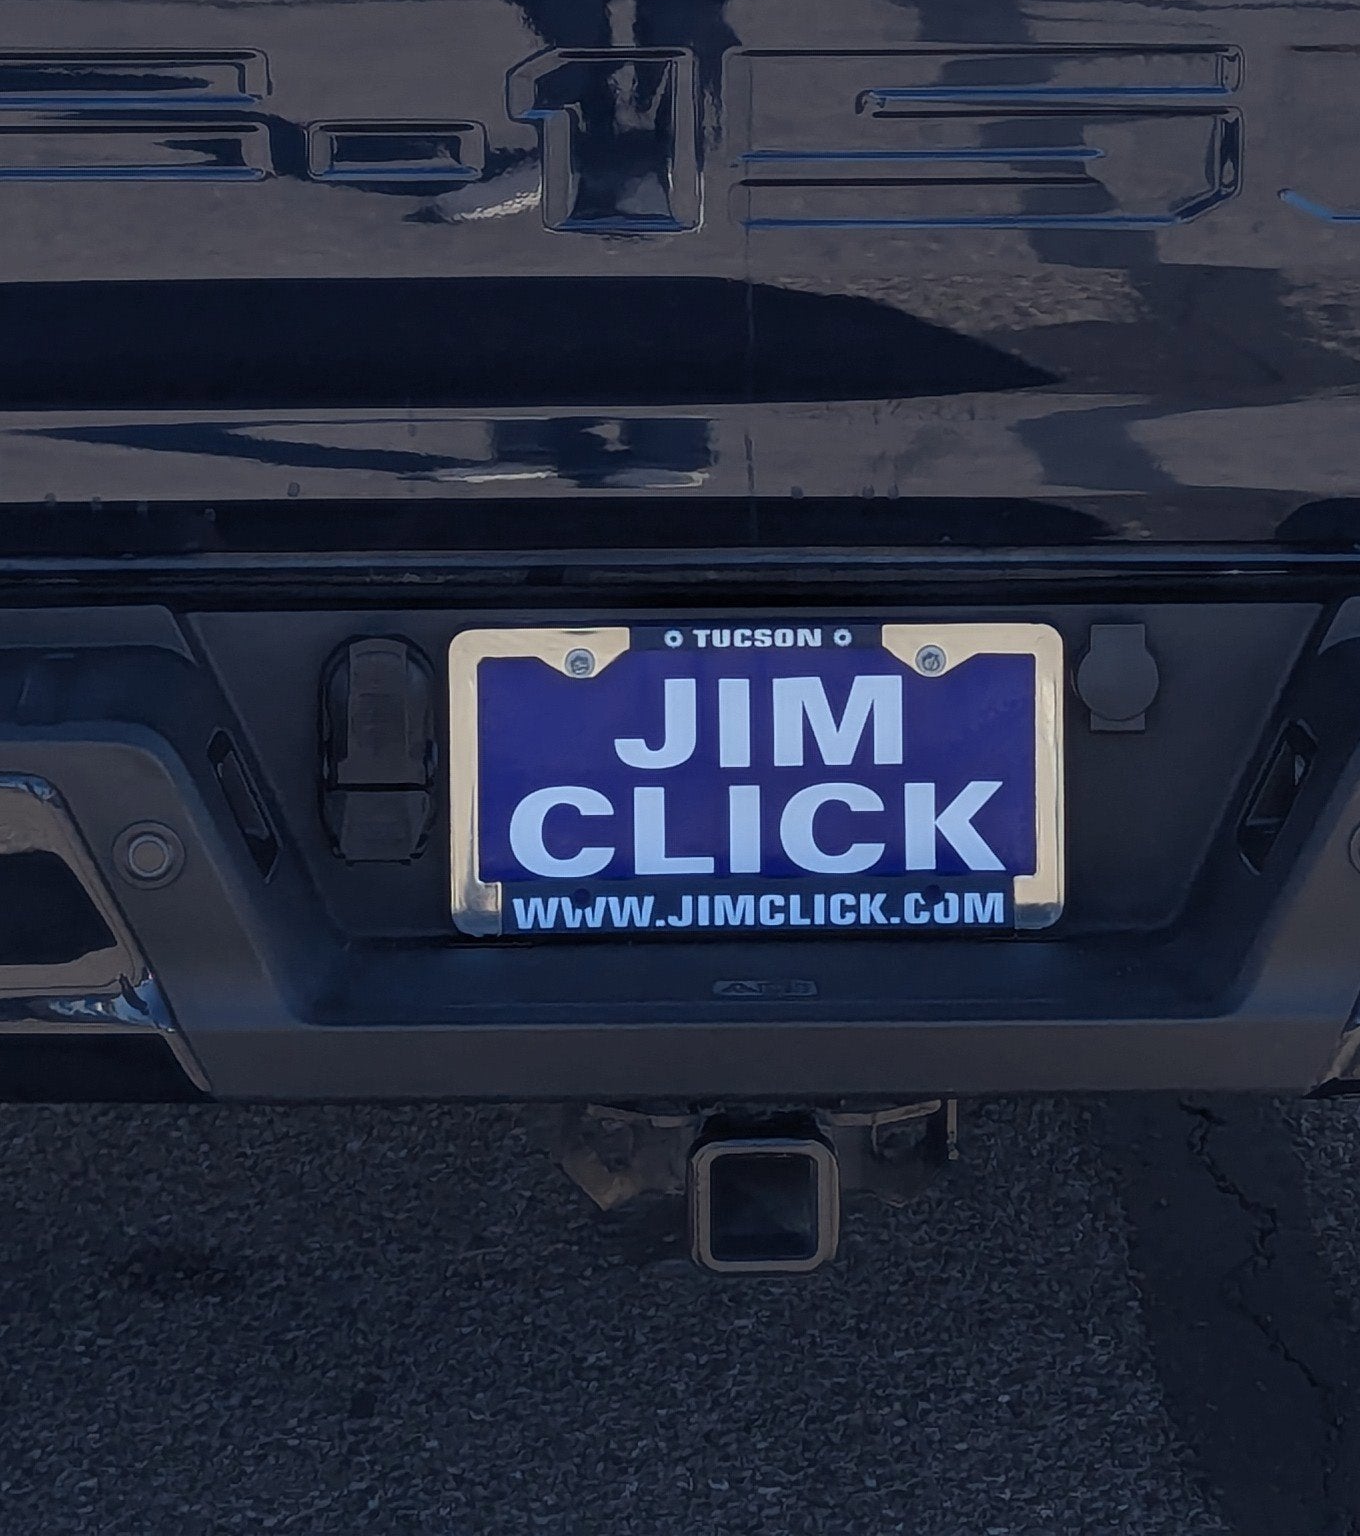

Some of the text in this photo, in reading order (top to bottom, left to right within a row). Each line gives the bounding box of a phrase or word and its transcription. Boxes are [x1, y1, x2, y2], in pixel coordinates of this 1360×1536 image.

[692, 628, 823, 649] TUCSON
[614, 674, 904, 770] JIM
[509, 781, 1007, 878] CLICK
[512, 892, 1004, 929] WWW.JIMCLICK.COM
